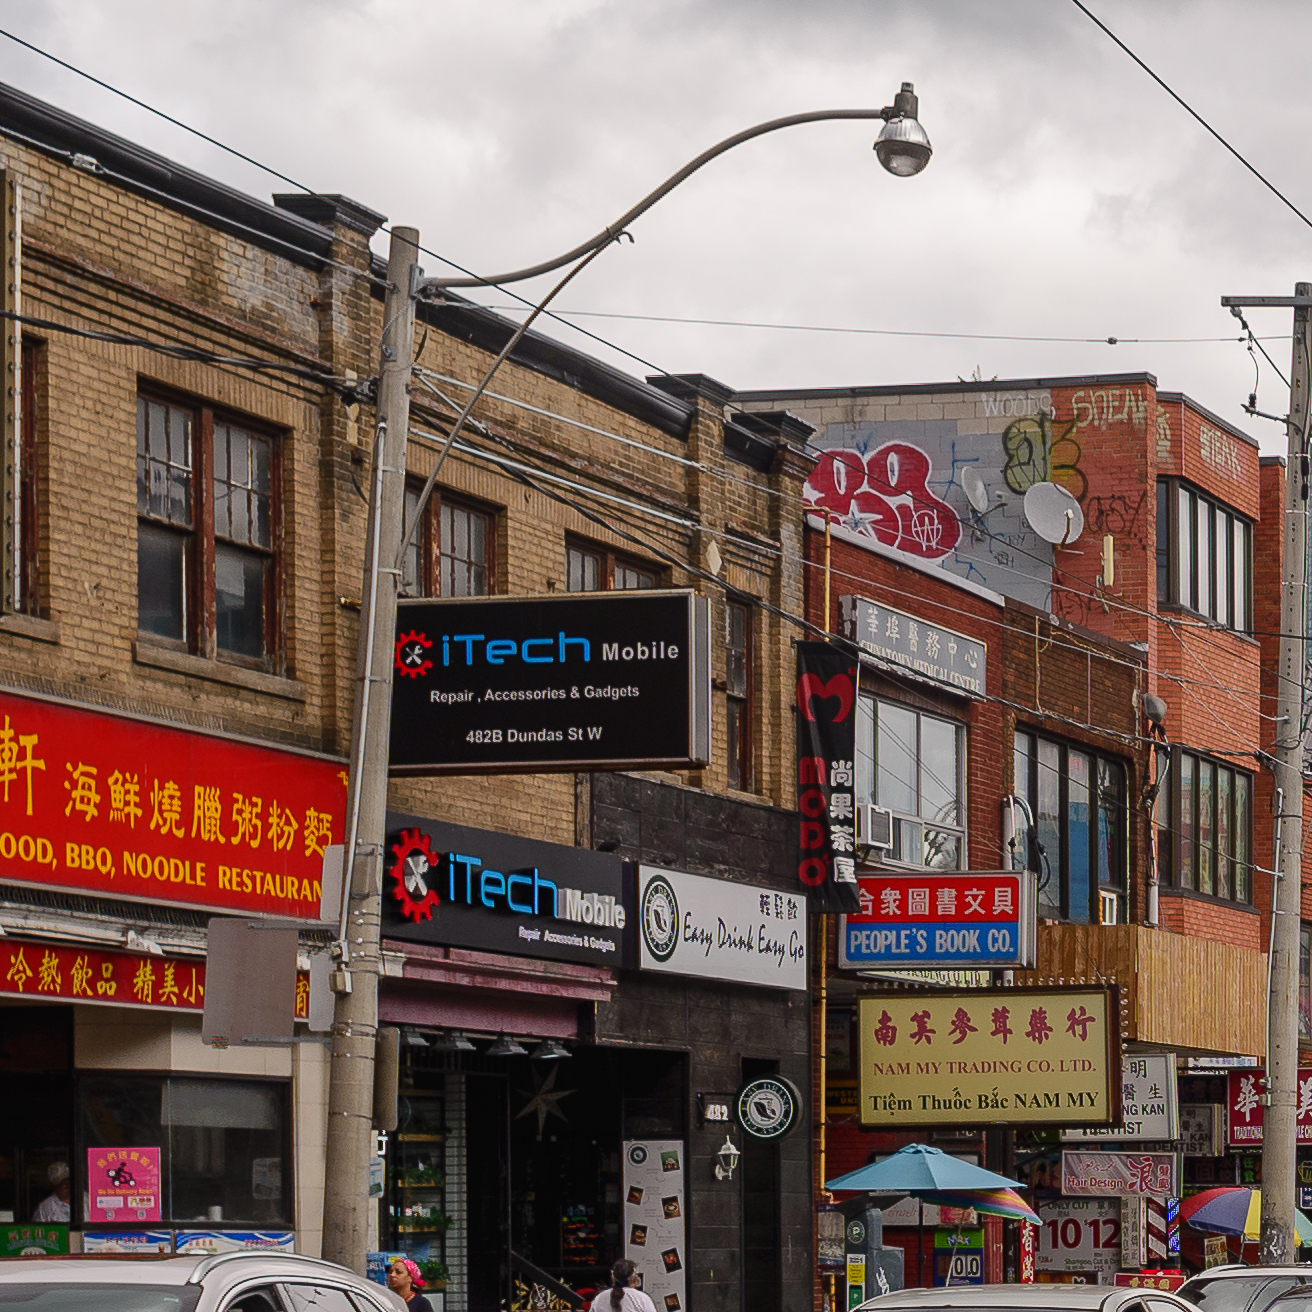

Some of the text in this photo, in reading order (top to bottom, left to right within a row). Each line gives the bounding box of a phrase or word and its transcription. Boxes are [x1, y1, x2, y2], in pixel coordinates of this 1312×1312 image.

[442, 631, 680, 667] iTech Mobile
[484, 684, 566, 702] Accessories
[570, 685, 580, 699] &
[584, 684, 640, 702] Gadgets
[466, 726, 603, 744] 482B Dundas St W
[829, 760, 858, 883] 尚果茶屋
[66, 842, 116, 879] BBQ,
[123, 852, 206, 887] NOODLE
[218, 865, 322, 902] RESTAURAN
[450, 852, 626, 930] iTech Mobile
[683, 911, 804, 968] Easy Drink Easy Go
[936, 929, 981, 953] BOOK
[987, 929, 1014, 953] CO.
[873, 1059, 1097, 1076] NAM MY TRADING CO. LTD.
[868, 1092, 913, 1116] Tiệm
[1013, 1092, 1061, 1109] NAM
[1066, 1091, 1100, 1108] MY
[1141, 1103, 1165, 1116] KAN
[1066, 1176, 1123, 1189] Hair Design
